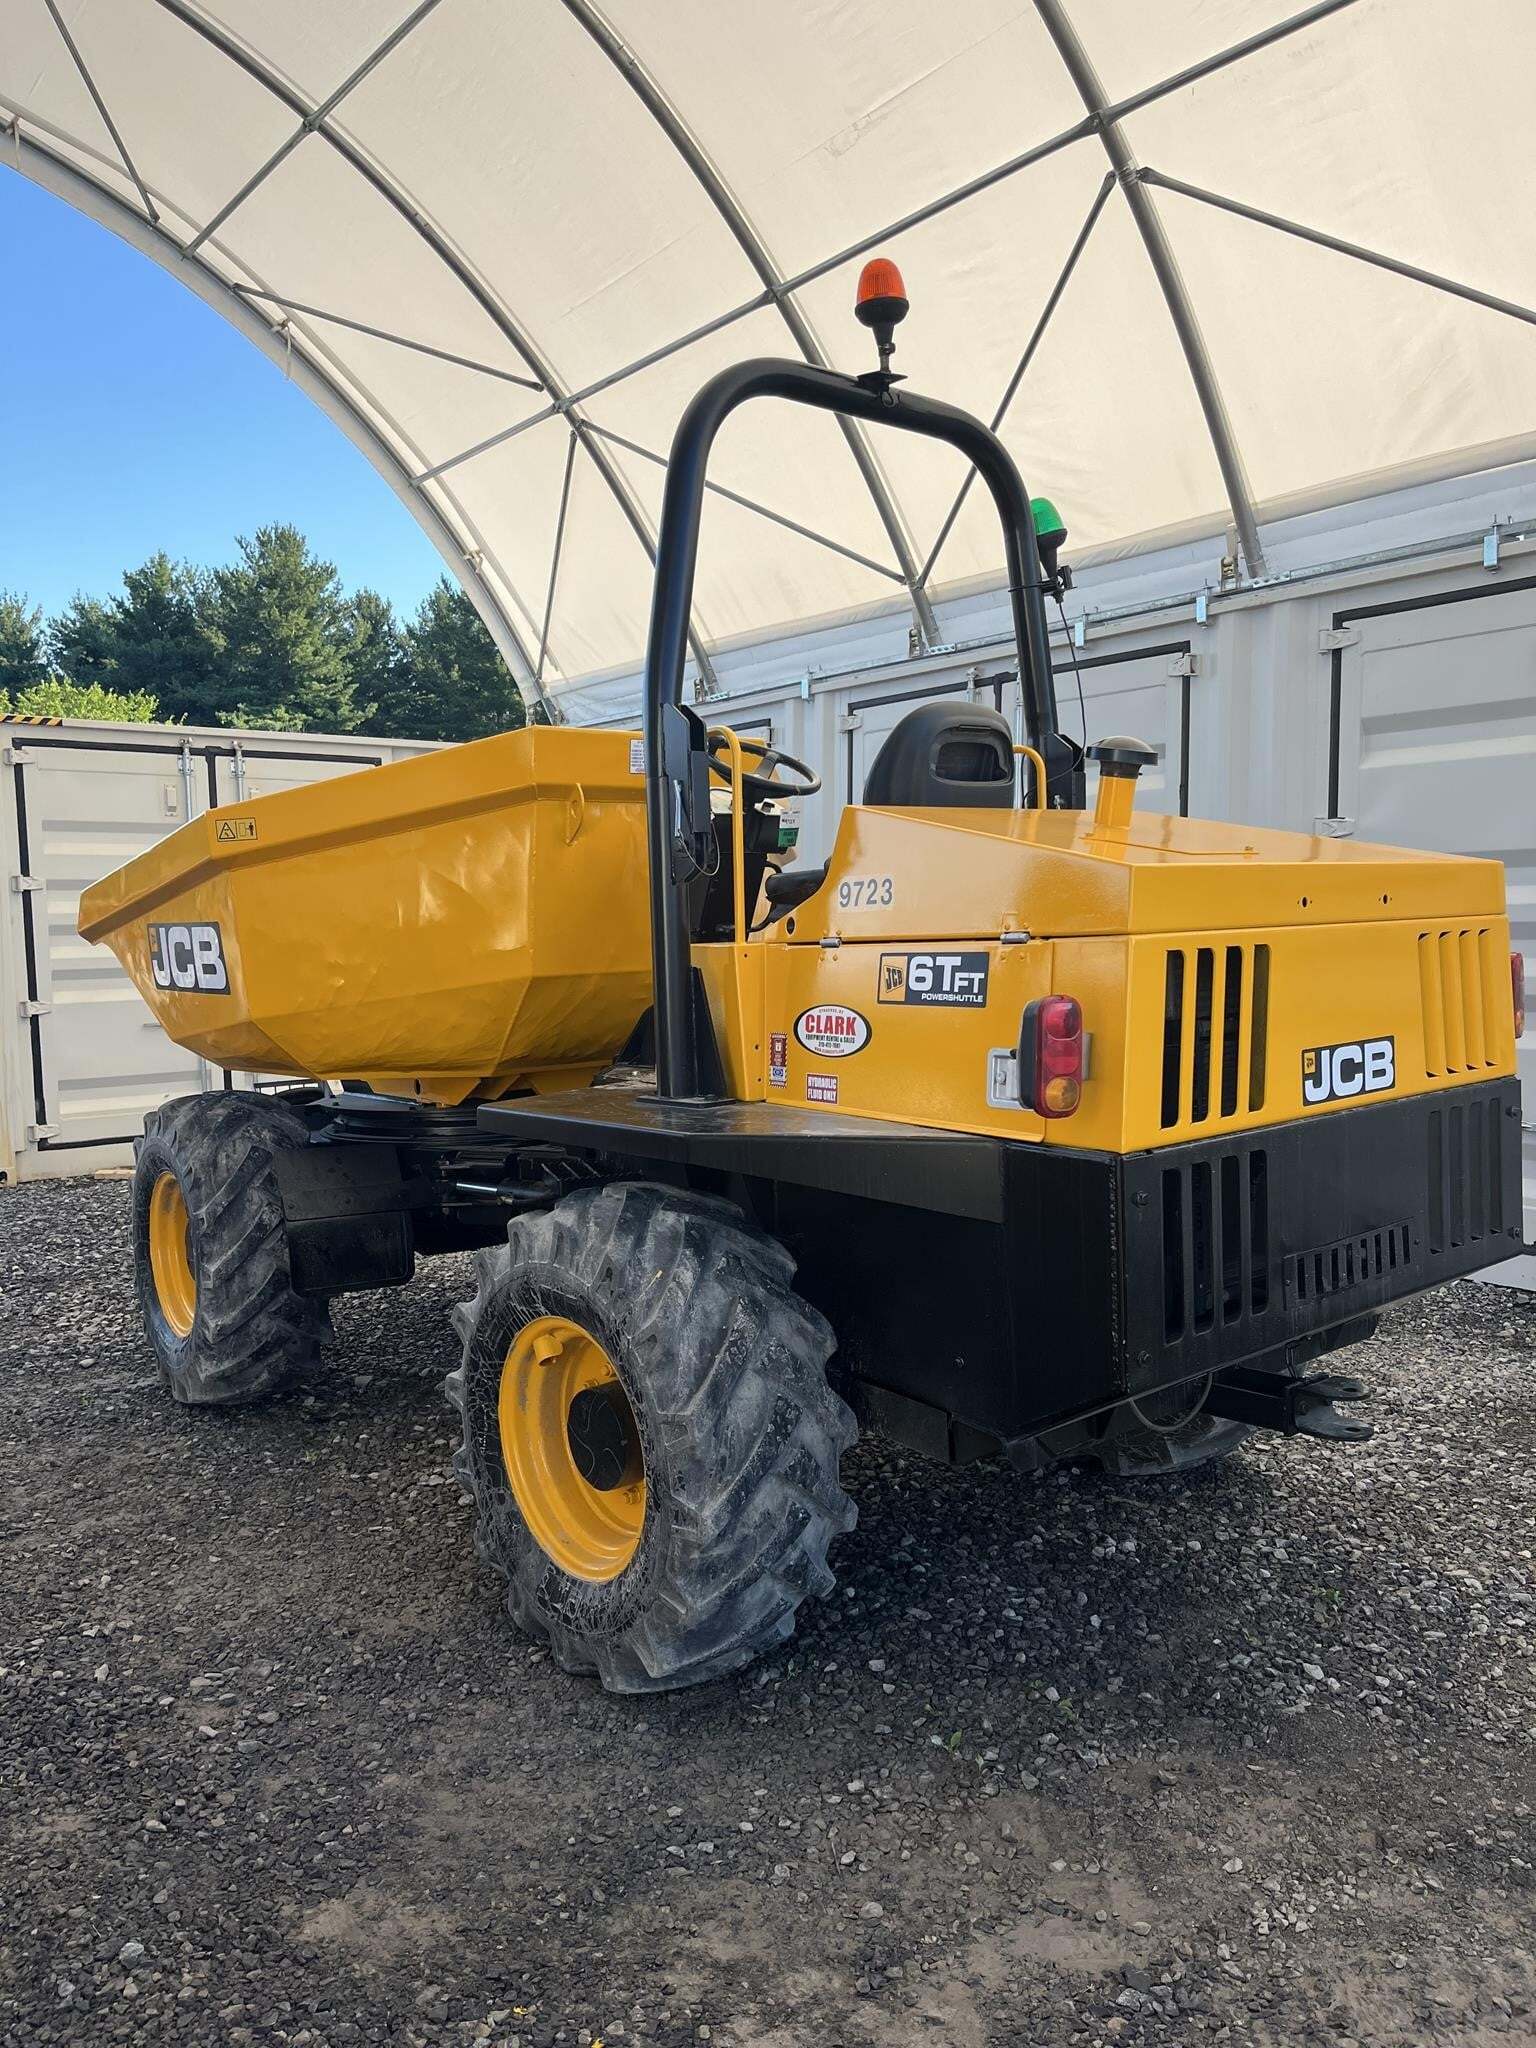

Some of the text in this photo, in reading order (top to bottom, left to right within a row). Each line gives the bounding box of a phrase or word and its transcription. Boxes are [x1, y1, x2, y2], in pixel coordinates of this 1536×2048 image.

[840, 878, 893, 907] 9723
[152, 926, 227, 990] JCB
[885, 966, 903, 991] JCB
[921, 993, 984, 1003] POWERSHUTTLE
[804, 1013, 857, 1037] CLARK
[808, 1076, 837, 1090] HYDRAULIC
[1304, 1040, 1394, 1102] JCB
[808, 1088, 837, 1102] FLUID ONLY
